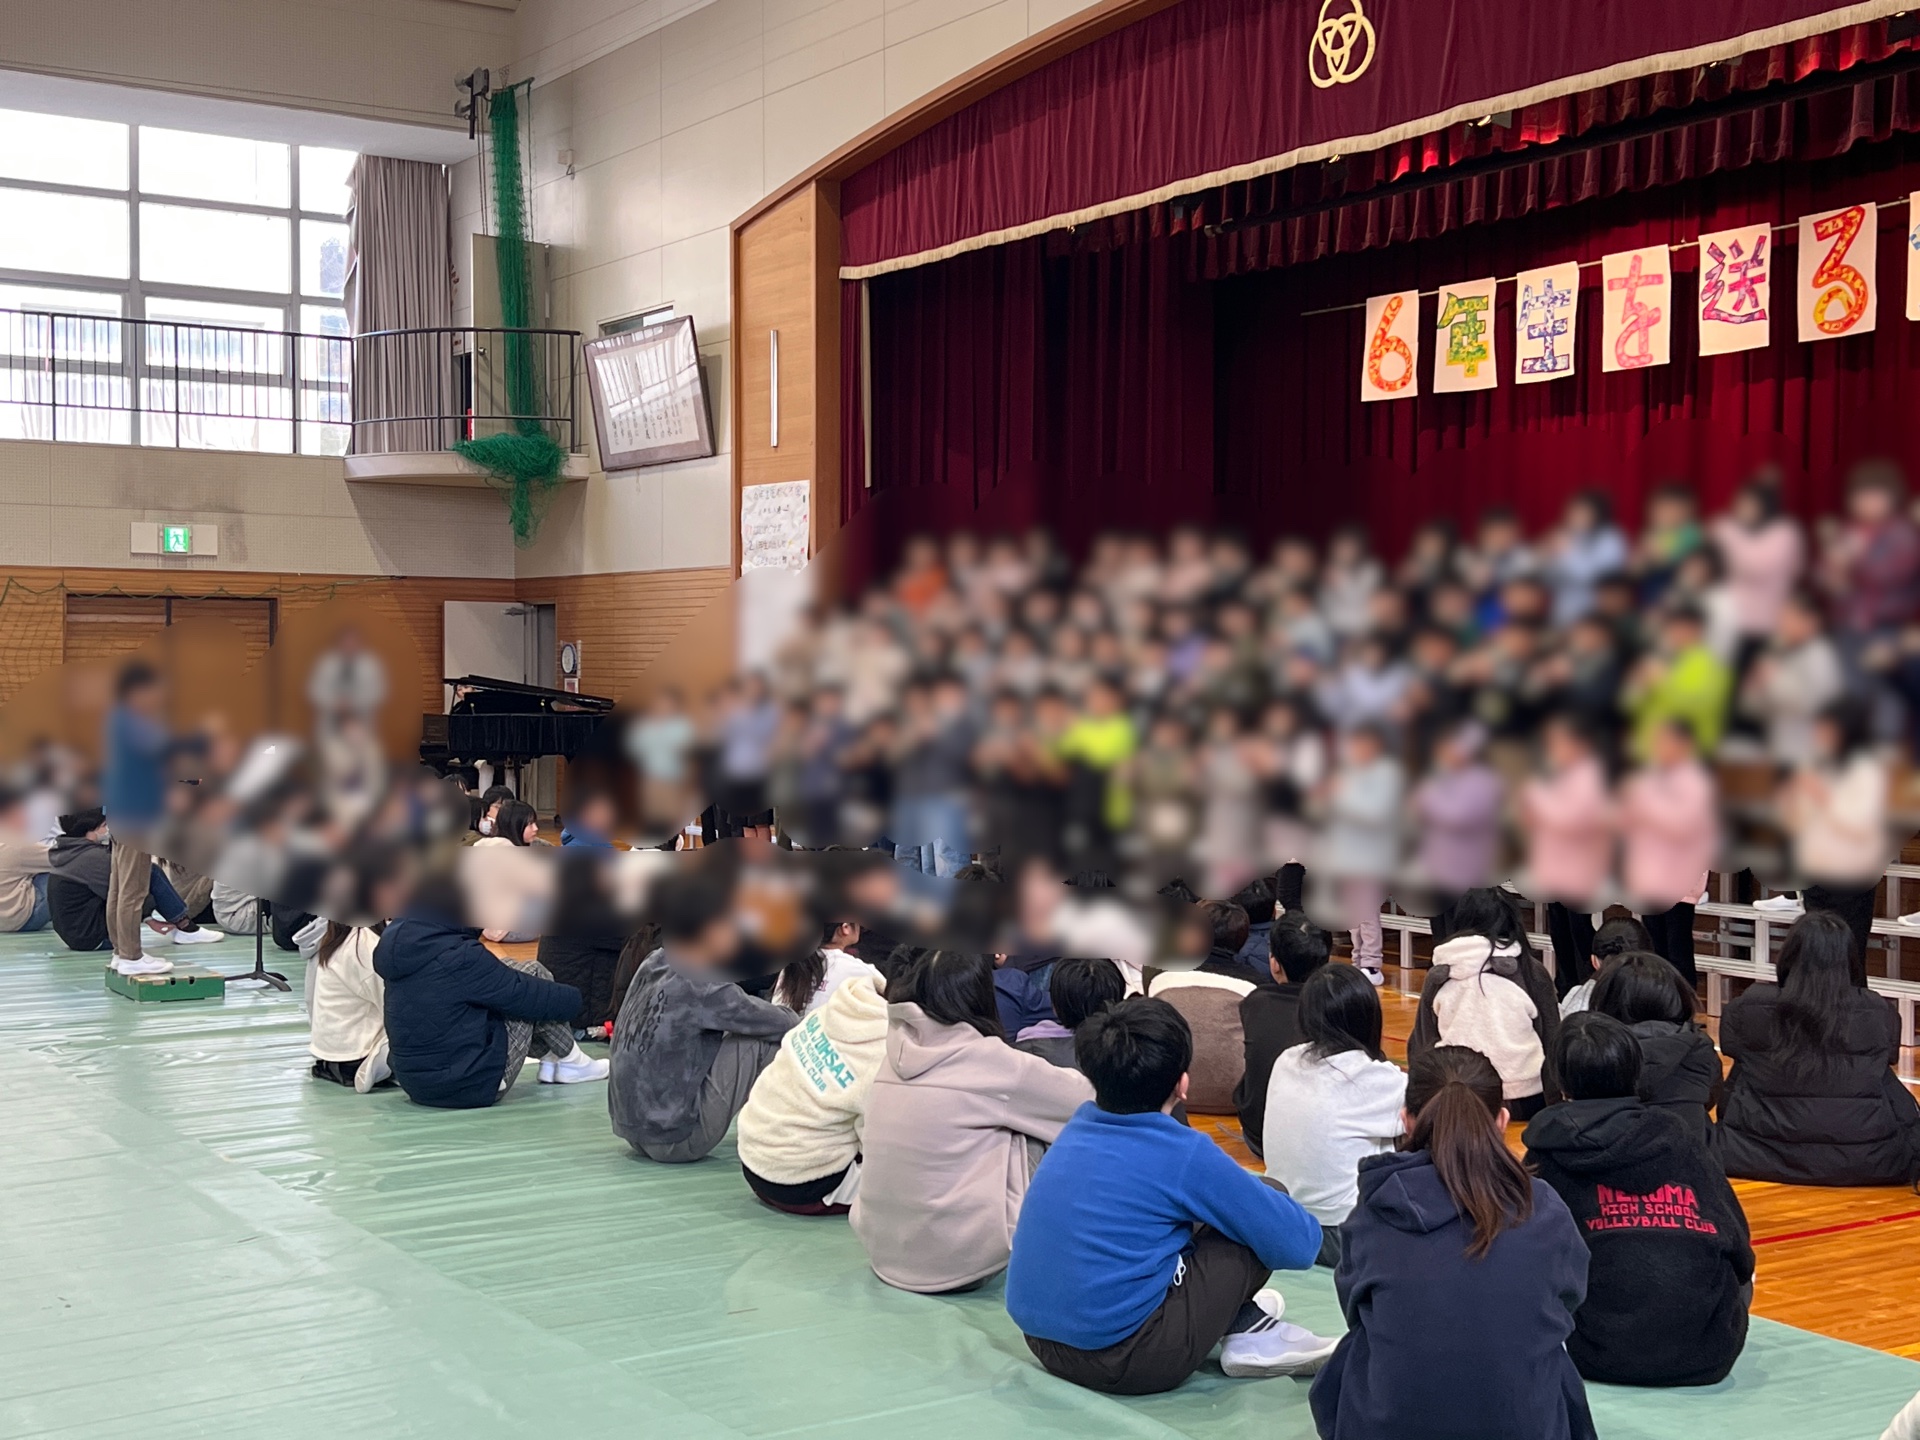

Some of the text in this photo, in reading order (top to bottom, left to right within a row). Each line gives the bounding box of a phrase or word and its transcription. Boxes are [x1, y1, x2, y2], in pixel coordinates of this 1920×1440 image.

[1368, 204, 1920, 392] 6年生を送る
[805, 1043, 825, 1074] SCHOOL
[807, 1067, 827, 1092] CLUB
[1601, 1204, 1700, 1219] HIGH SCHOOL
[1586, 1215, 1717, 1234] VOLLEYBALL CLUB
